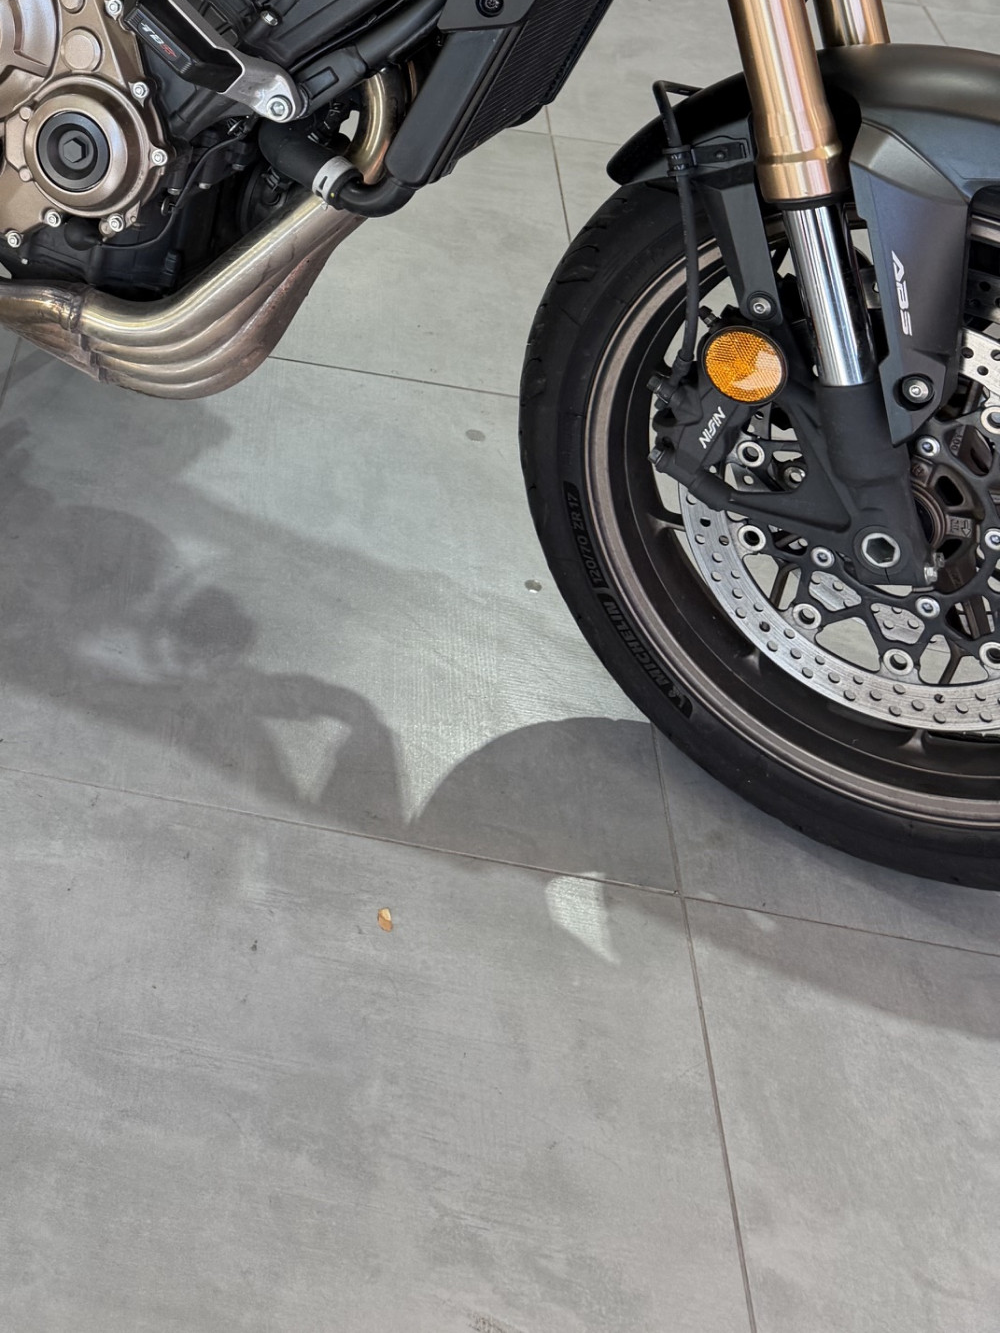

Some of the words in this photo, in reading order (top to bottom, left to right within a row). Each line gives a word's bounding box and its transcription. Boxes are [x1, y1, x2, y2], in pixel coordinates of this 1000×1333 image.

[891, 250, 913, 337] ABS
[698, 406, 726, 449] NISSIN
[567, 492, 580, 509] 17
[570, 511, 583, 530] ZR
[577, 534, 603, 586] 120/70
[602, 601, 672, 686] MICHELIN
